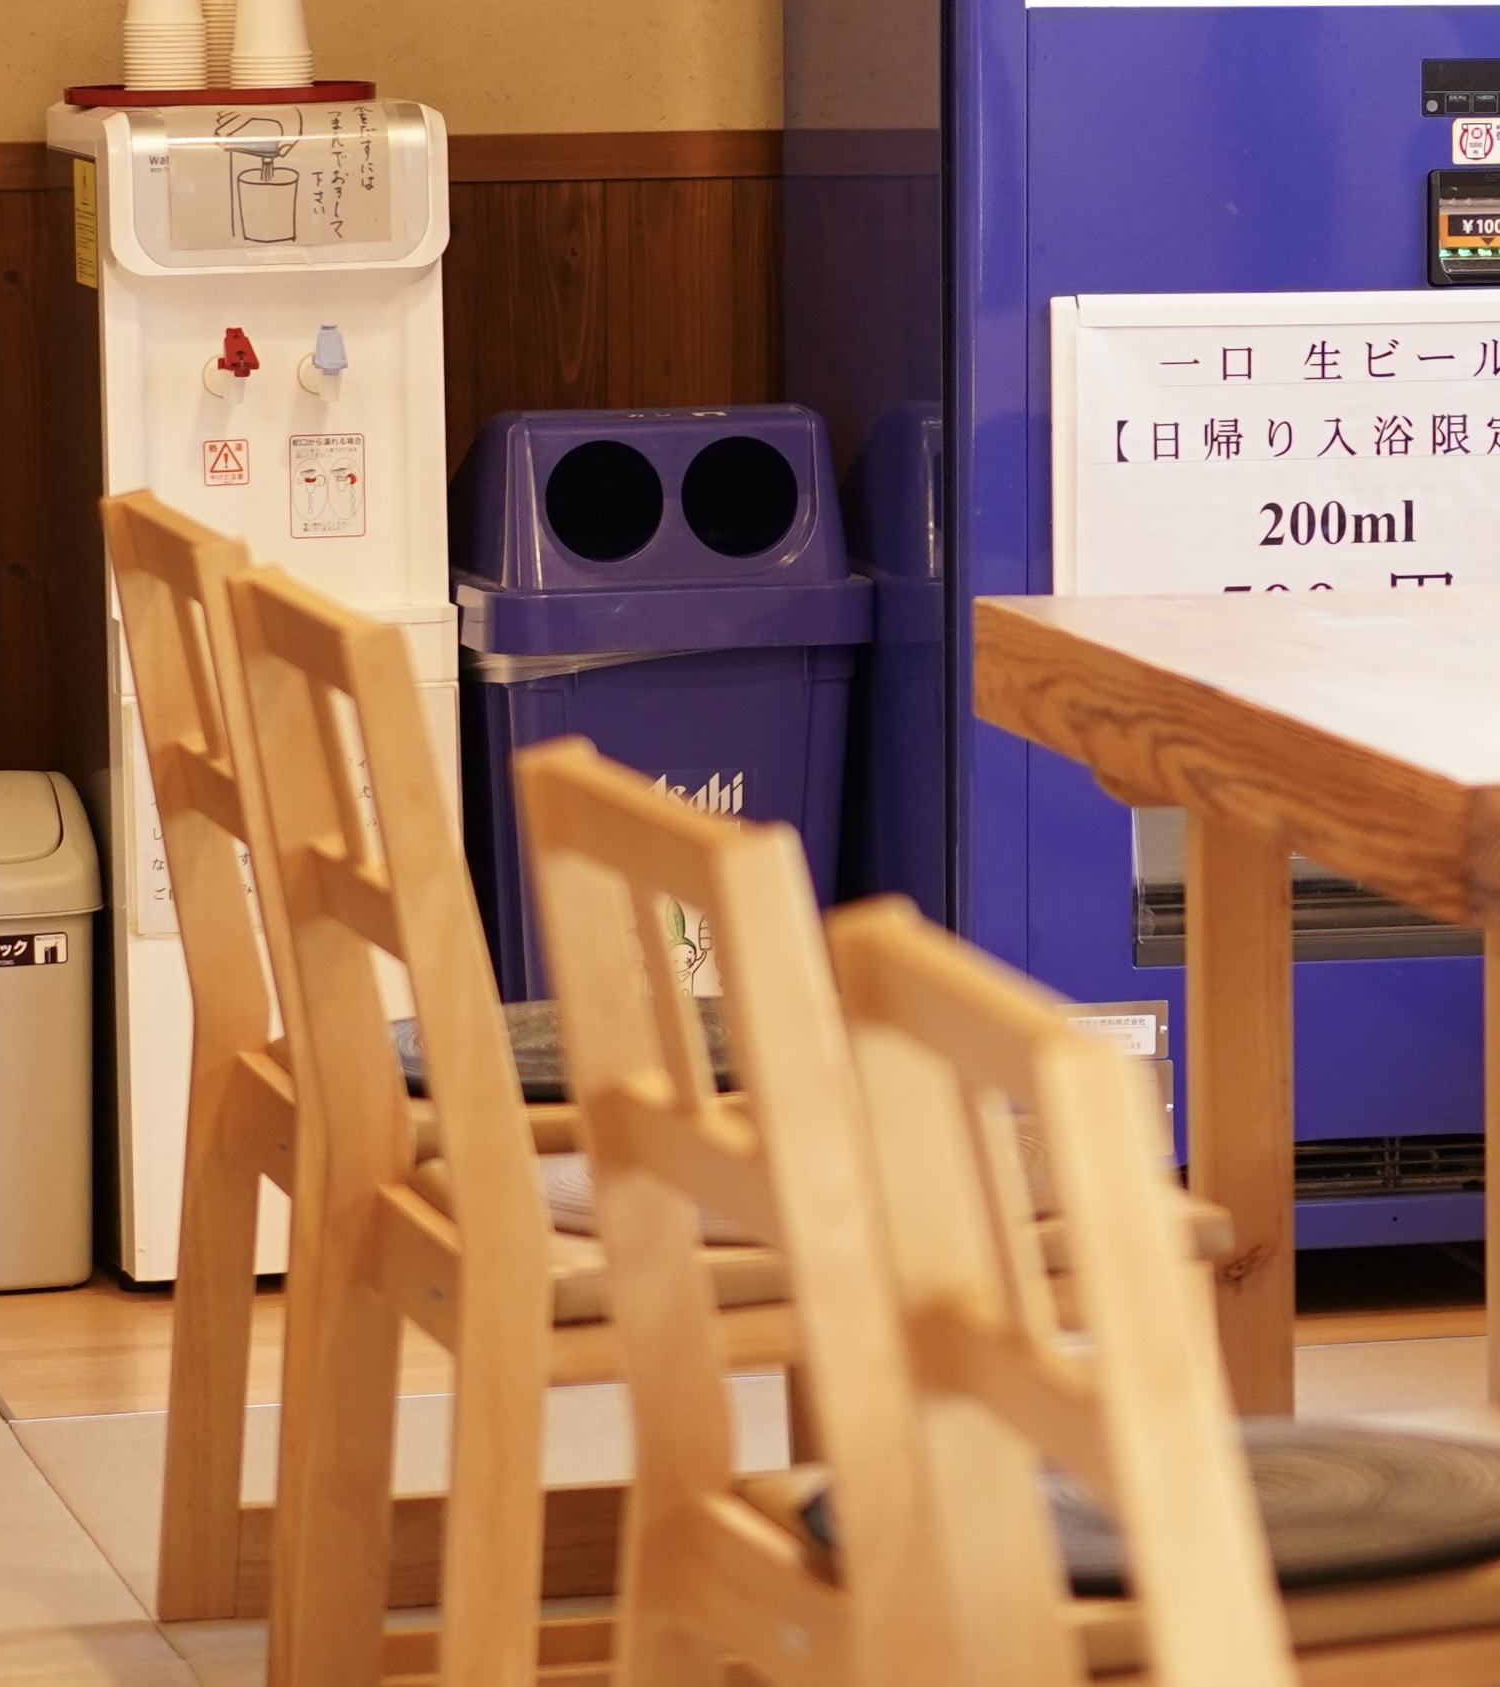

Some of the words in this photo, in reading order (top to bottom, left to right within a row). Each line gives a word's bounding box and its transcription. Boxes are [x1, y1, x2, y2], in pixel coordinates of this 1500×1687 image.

[311, 171, 326, 215] 下さい
[1159, 342, 1254, 382] 一口
[292, 437, 361, 446] 蛇口から漏れる場合
[1258, 499, 1416, 547] 200ml
